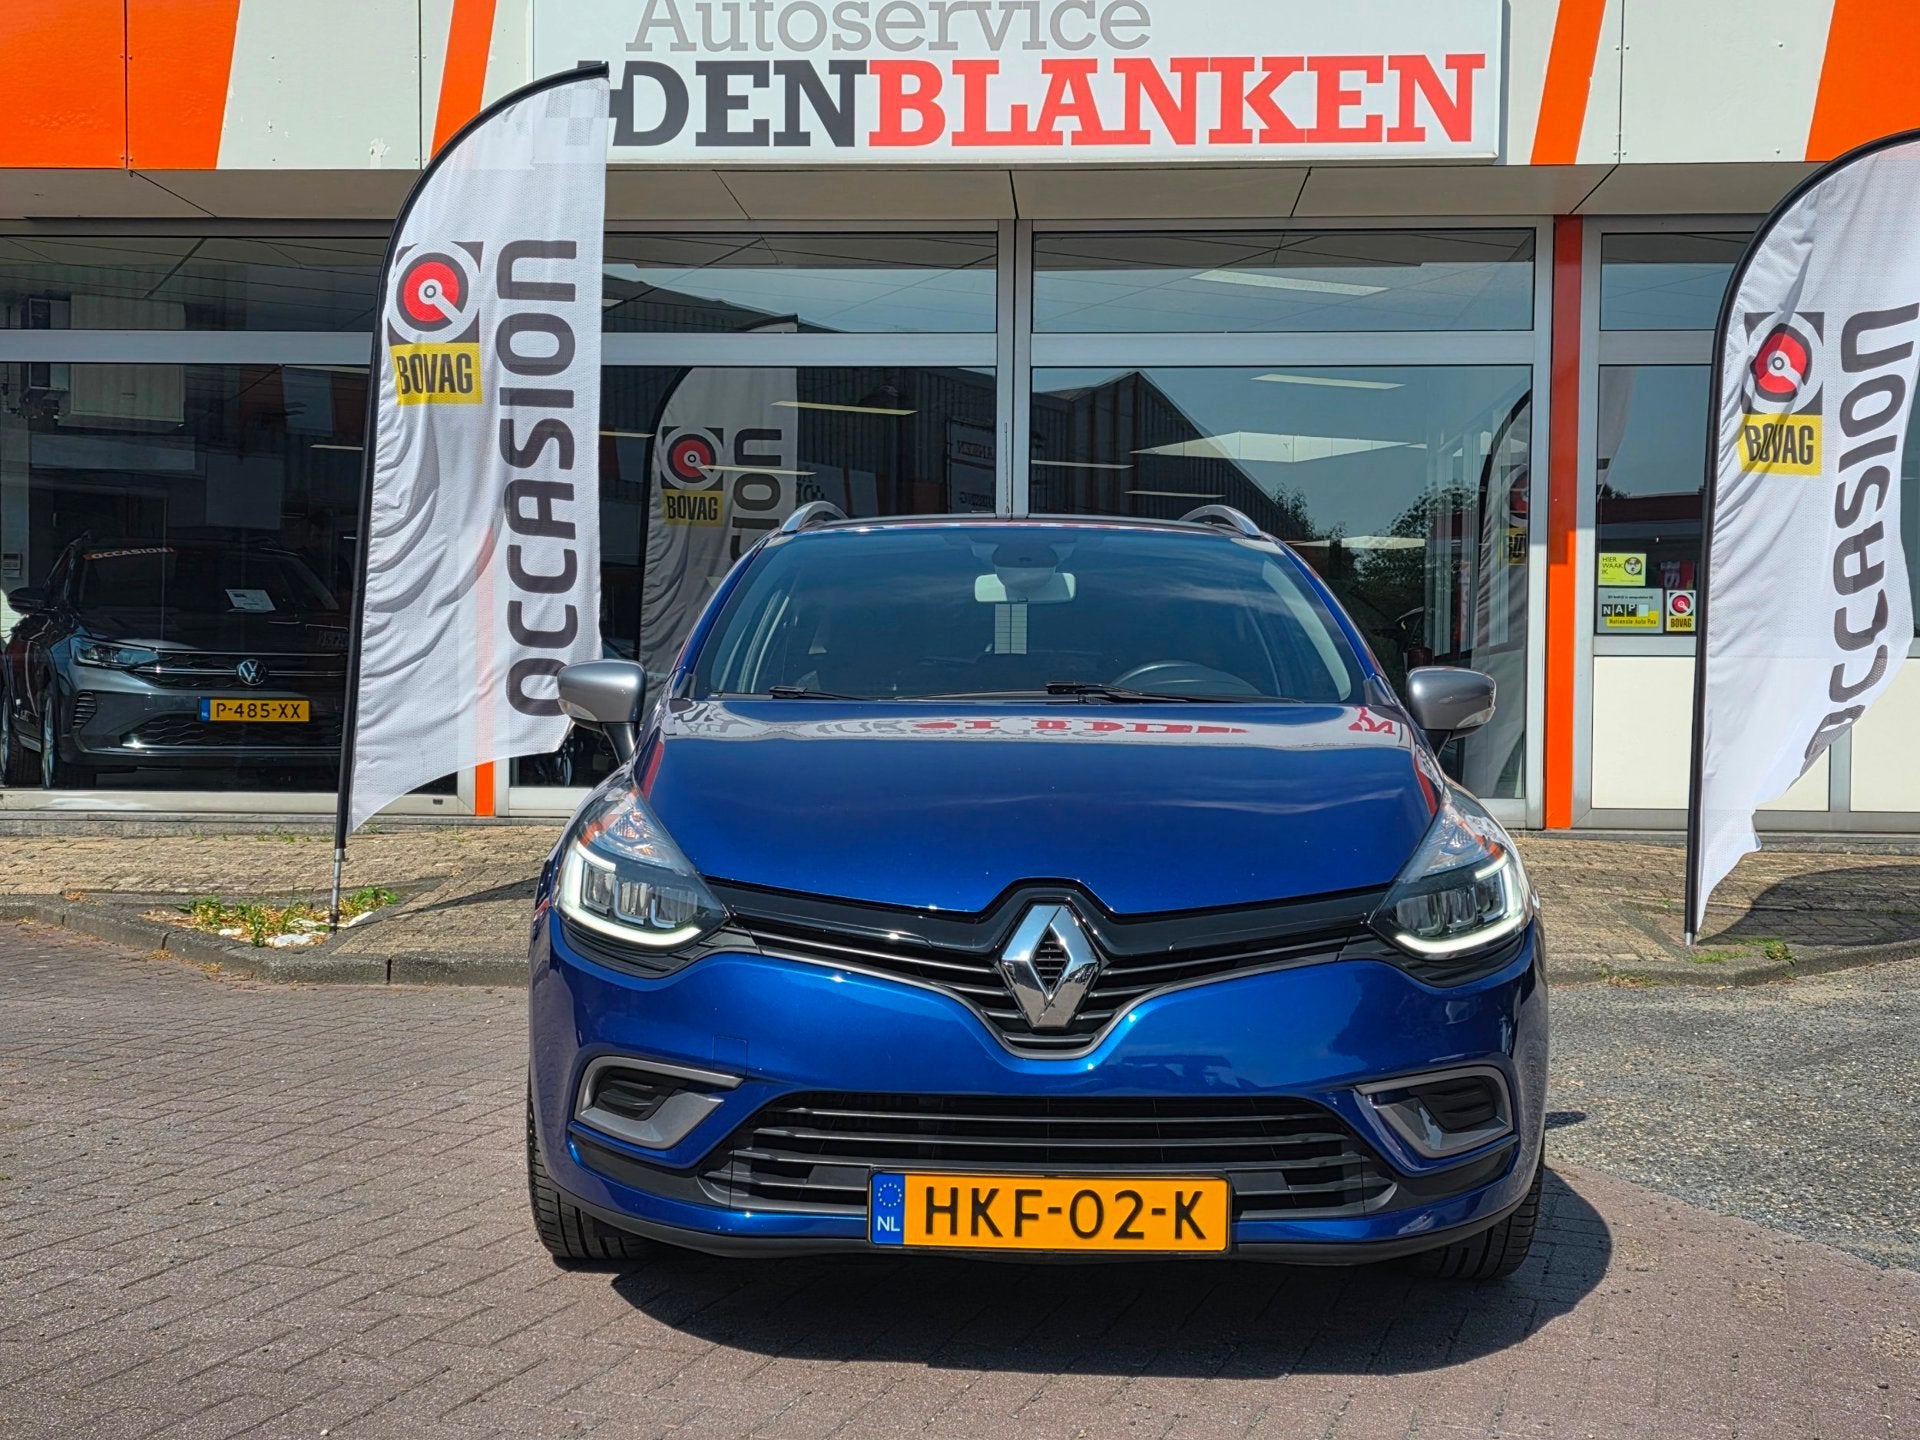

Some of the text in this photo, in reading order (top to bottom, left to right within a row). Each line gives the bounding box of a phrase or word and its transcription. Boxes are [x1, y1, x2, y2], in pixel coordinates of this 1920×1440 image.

[624, 0, 1152, 53] Autoservice
[396, 352, 473, 395] BOVAG
[1744, 422, 1815, 466] BOVAG
[495, 239, 578, 717] OCCASION
[666, 495, 718, 521] BOVAG
[91, 546, 167, 560] OCCASION
[1603, 603, 1636, 615] NAP
[1670, 618, 1692, 628] BOVAG
[216, 702, 301, 719] P-485-XX
[877, 1215, 901, 1232] NL
[925, 1186, 1207, 1240] HKF-02-K
